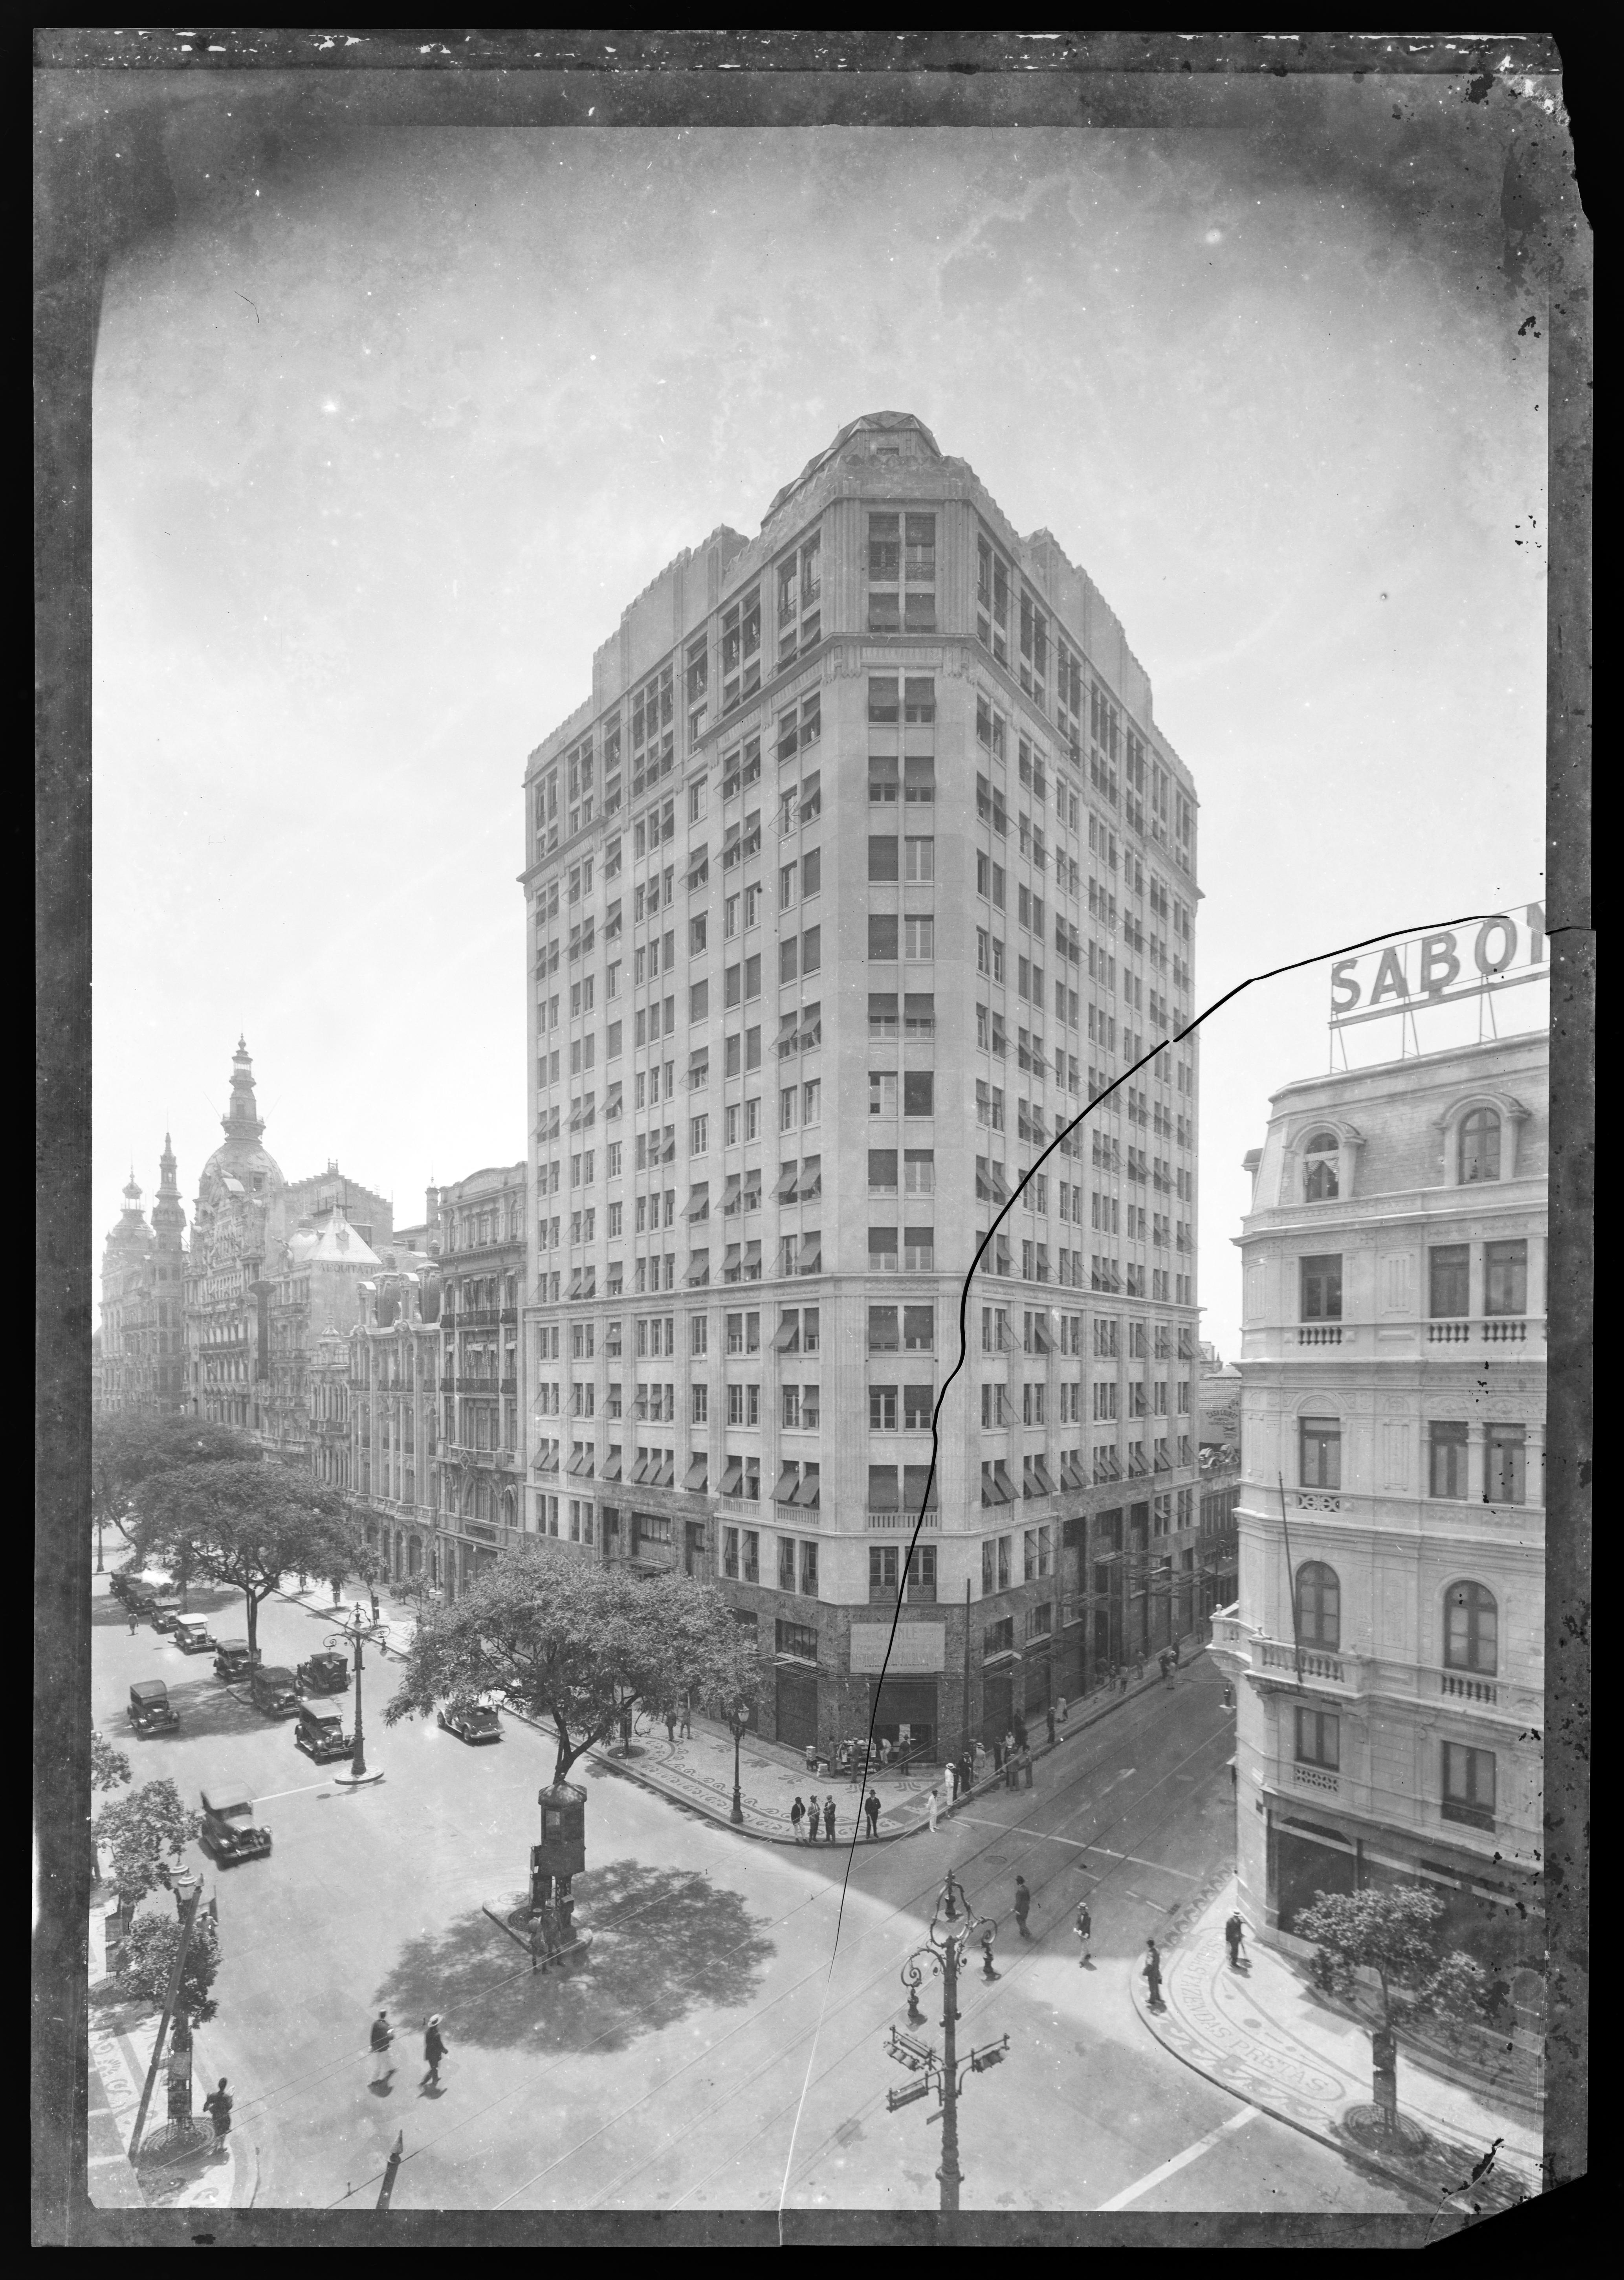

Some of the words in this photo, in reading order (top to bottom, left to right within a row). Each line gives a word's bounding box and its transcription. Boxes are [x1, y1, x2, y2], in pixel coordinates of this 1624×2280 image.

[877, 1626, 918, 1640] GUNLE
[1180, 1974, 1232, 2038] FAZENDAS
[1228, 2040, 1329, 2091] PRETAS
